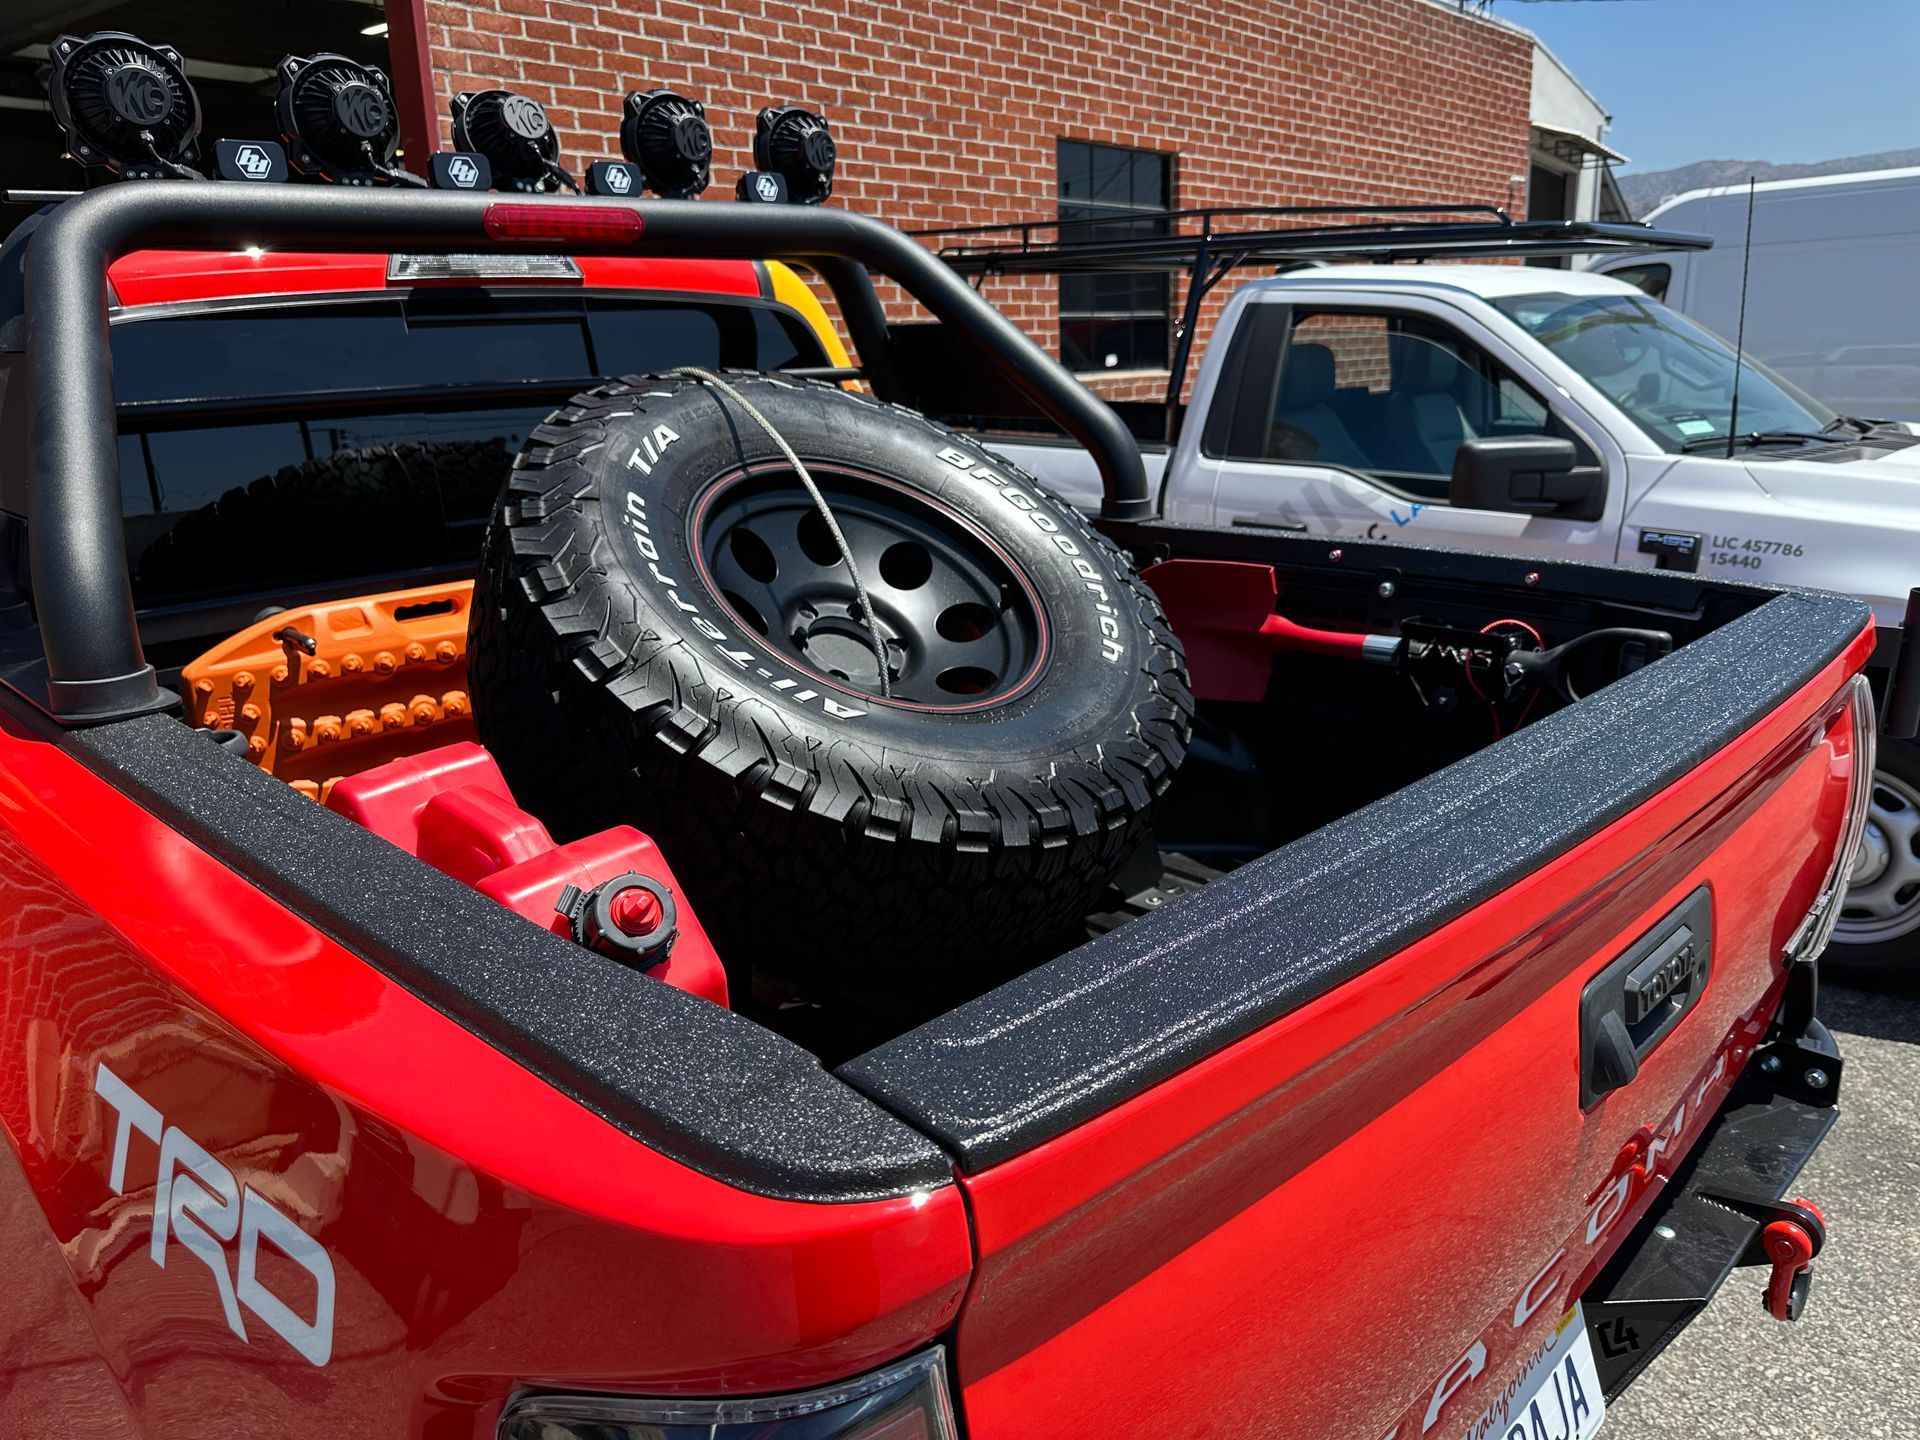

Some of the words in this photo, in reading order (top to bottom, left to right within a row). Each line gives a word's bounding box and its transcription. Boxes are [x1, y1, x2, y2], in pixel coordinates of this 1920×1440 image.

[115, 71, 165, 121] KC
[345, 89, 384, 132] KC
[506, 98, 545, 135] KC
[626, 424, 681, 476] T/A
[935, 446, 1122, 663] BFGoodrich
[1709, 552, 1762, 569] 15440
[1712, 535, 1739, 550] LIC
[1742, 538, 1804, 557] 457786
[622, 490, 868, 720] All-Terrain
[1640, 942, 1696, 1013] TOYOTA
[94, 1062, 337, 1368] TRD
[1507, 1353, 1590, 1440] AJA
